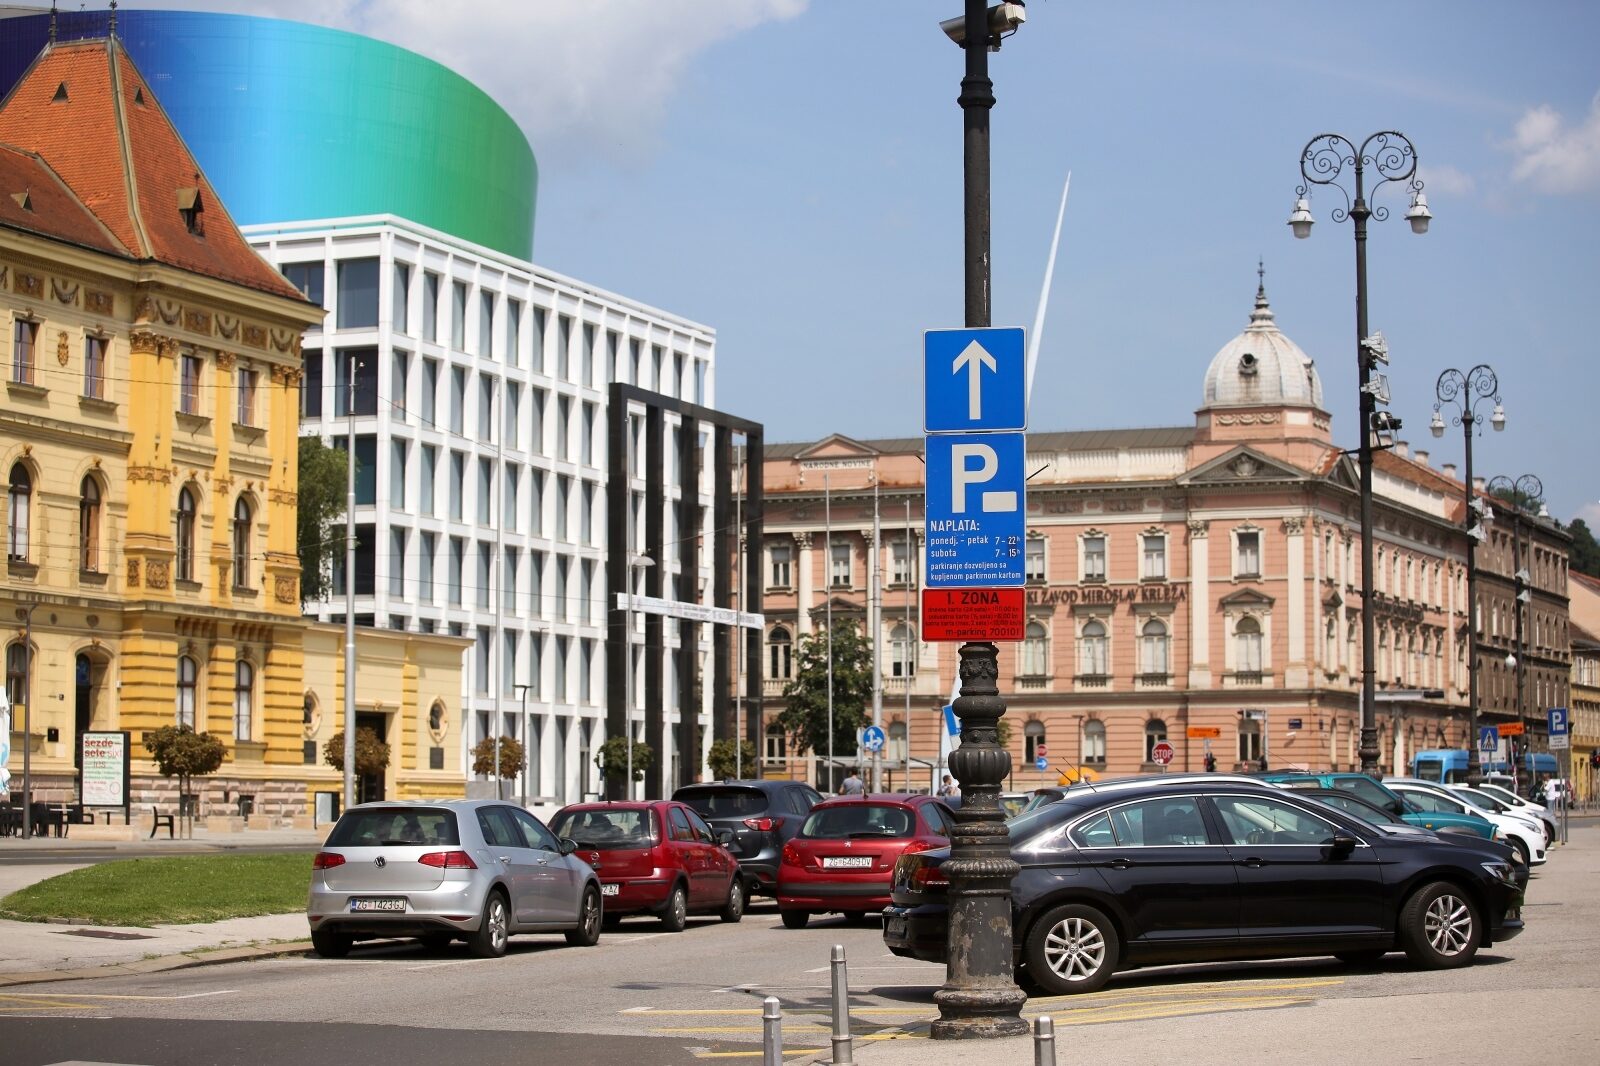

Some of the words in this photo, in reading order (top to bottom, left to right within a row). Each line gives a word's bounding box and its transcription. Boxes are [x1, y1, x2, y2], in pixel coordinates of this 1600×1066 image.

[803, 461, 839, 469] NARODNE
[842, 460, 872, 468] NOVINE
[951, 443, 999, 514] P
[930, 519, 980, 532] NAPLATA:
[930, 535, 958, 547] ponedj.
[967, 535, 989, 546] petak
[930, 548, 957, 558] subota
[930, 563, 962, 571] parkiranje
[964, 561, 998, 571] dozvoljeno
[930, 573, 964, 581] kupljenom
[965, 572, 998, 581] parkirnom
[998, 571, 1021, 579] kartom
[961, 591, 1000, 605] ZONA
[1041, 589, 1078, 604] ZAVOD
[1081, 587, 1139, 604] MIROSLAV
[1141, 584, 1186, 602] KRLEŽA
[1154, 749, 1173, 759] STOP
[357, 899, 367, 910] ZG
